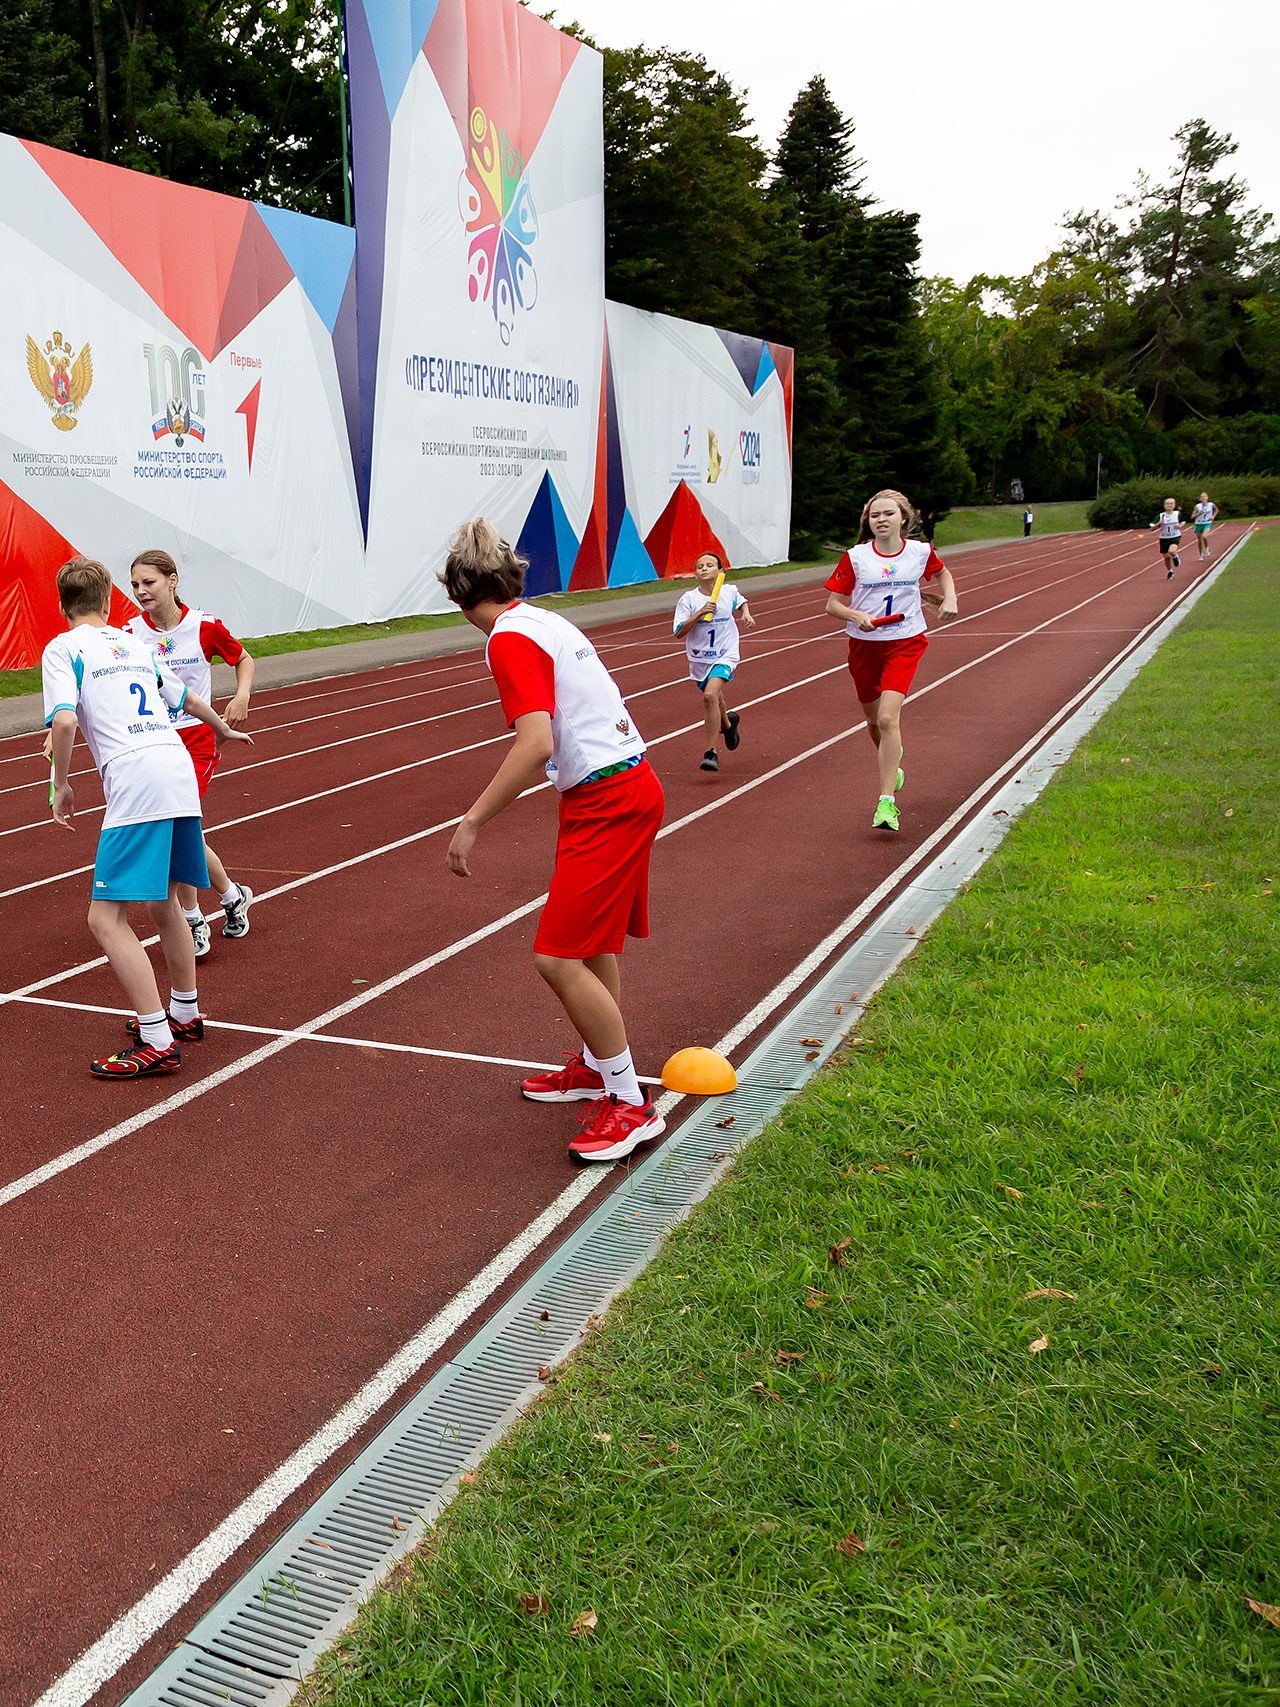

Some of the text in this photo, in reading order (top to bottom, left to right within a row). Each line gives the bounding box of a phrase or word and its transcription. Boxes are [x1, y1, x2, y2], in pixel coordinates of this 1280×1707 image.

[230, 352, 262, 371] Первые
[192, 373, 206, 386] ЛЕТ
[405, 354, 579, 409] «ПРЕЗИДЕНТСКИЕ СОСТЯЗАНИЯ»
[137, 450, 224, 464] МИНИСТЕРСТВО СПОРТА
[742, 430, 761, 467] 2024
[12, 453, 119, 465] МИНИСТЕРСТВО ПРОСВЕЩЕНИЯ
[24, 465, 111, 478] РОССИЙСКОЙ ФЕДЕРАЦИИ
[133, 463, 227, 480] РОССИЙСКОЙ ФЕДЕРАЦИИ
[882, 594, 894, 617] 1
[707, 629, 716, 648] 1
[170, 657, 199, 666] СОСТЯЗАНИЯ
[129, 682, 154, 716] 2
[128, 722, 145, 735] ВДЦ
